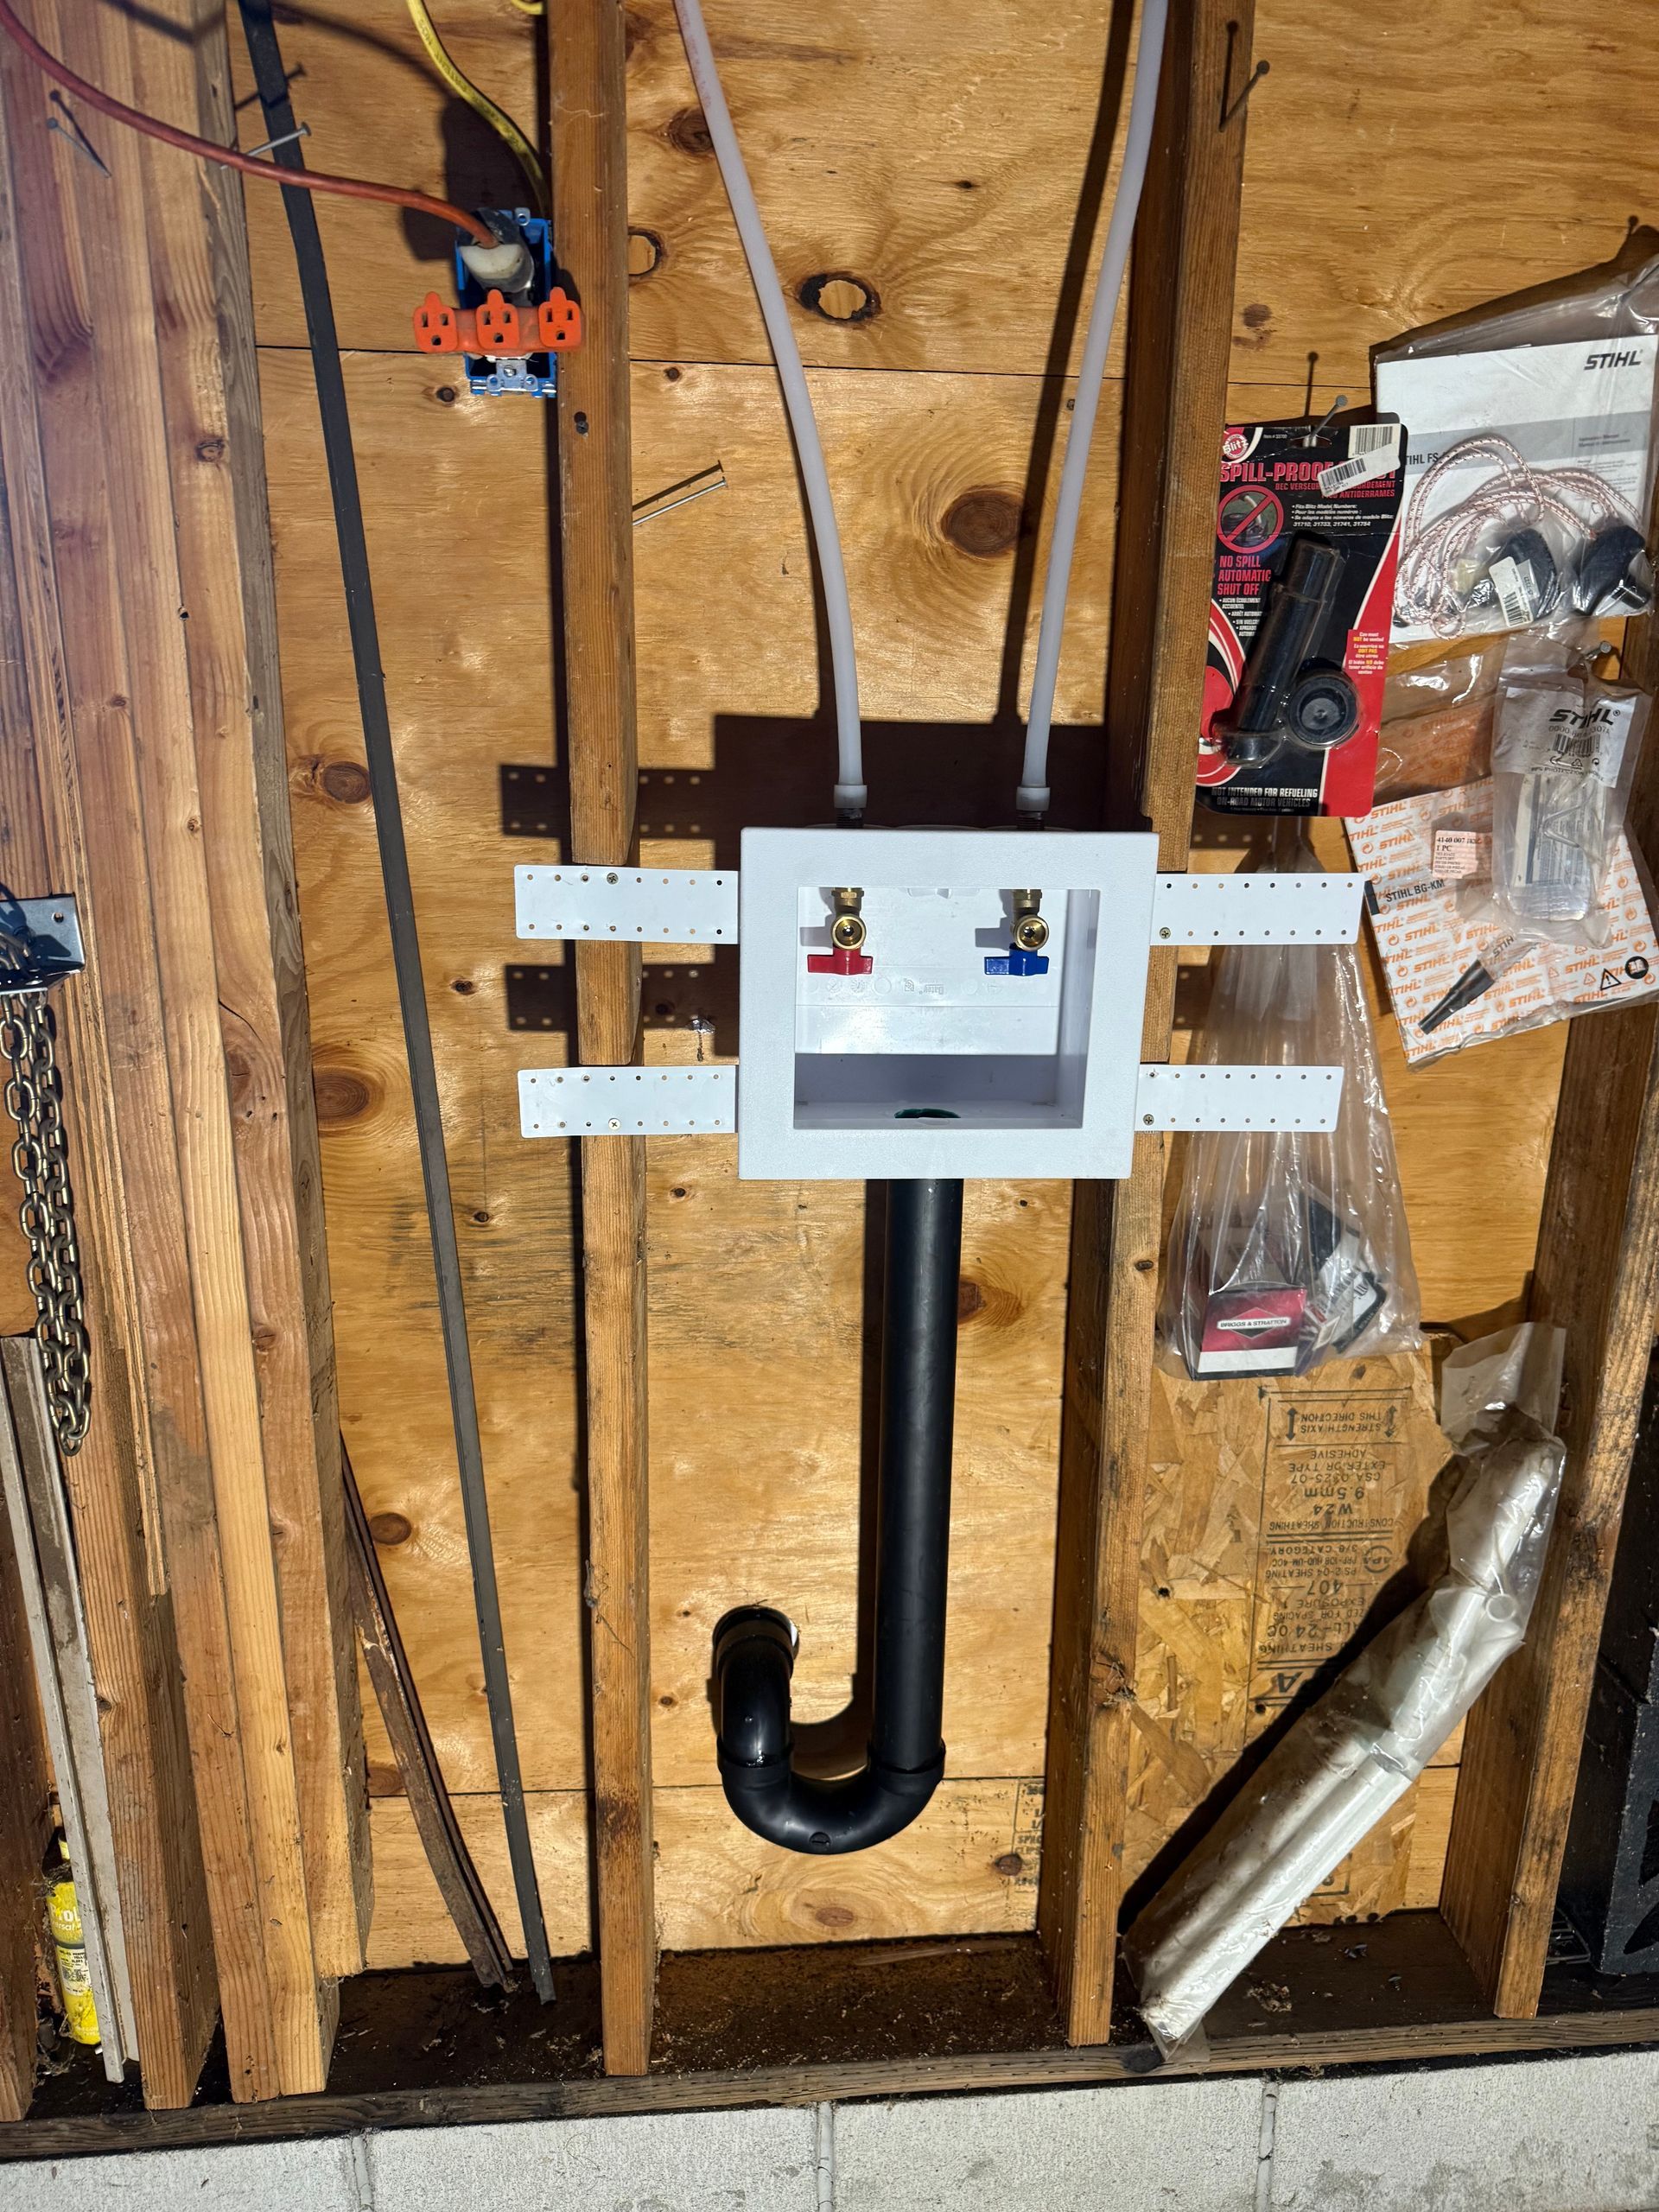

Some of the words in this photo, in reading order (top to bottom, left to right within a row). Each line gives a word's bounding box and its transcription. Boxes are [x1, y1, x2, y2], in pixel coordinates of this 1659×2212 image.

[1584, 350, 1641, 370] STIHL
[1406, 454, 1425, 465] IHL
[1340, 489, 1395, 498] ANTIDERRAMES
[1219, 555, 1233, 568] NO
[1236, 555, 1261, 568] SPILL
[1218, 569, 1271, 582] AUTOMATIC
[1217, 583, 1242, 595] SHUT
[1243, 583, 1260, 595] OFF
[1549, 708, 1614, 729] STIHL
[1227, 786, 1262, 797] INTENDED
[1264, 787, 1278, 797] FOR
[1280, 788, 1318, 798] REFUELING
[1250, 798, 1276, 807] MOTOR
[1277, 798, 1311, 807] VEHICLES
[1370, 803, 1406, 819] STIHL
[1348, 827, 1377, 842] TIHL
[1357, 857, 1387, 873] TIHL
[1385, 887, 1414, 902] STIHL
[1414, 879, 1446, 894] BG-KM
[1374, 918, 1403, 933] TIHL
[1405, 924, 1440, 942] STIHL
[1492, 936, 1514, 958] STIH
[1382, 950, 1412, 965] TIHL
[1566, 956, 1599, 974] STIHL
[1390, 982, 1421, 996] TIHL
[1573, 991, 1607, 1005] STIHL
[1300, 1412, 1355, 1422] DIRECTION
[1360, 1412, 1382, 1421] THIS
[1300, 1424, 1322, 1433] AXIS
[1328, 1422, 1382, 1433] STRENGTH
[1310, 1449, 1366, 1459] ADHESIVE
[1288, 1463, 1318, 1473] TYPE
[1357, 1471, 1381, 1481] CSA
[1269, 1520, 1319, 1531] SHEATHING
[1323, 1517, 1394, 1529] CONSTRUCTION
[1270, 1545, 1332, 1555] CATEGORY
[1345, 1567, 1357, 1575] PS
[1307, 1579, 1344, 1595] 407
[1297, 1596, 1365, 1608] EXPOSURE
[1273, 1611, 1314, 1621] SPACING
[1320, 1610, 1340, 1619] FOR
[1347, 1609, 1363, 1618] ZED
[1296, 1621, 1357, 1638] ALL-24
[1259, 1643, 1332, 1654] SHEATHING
